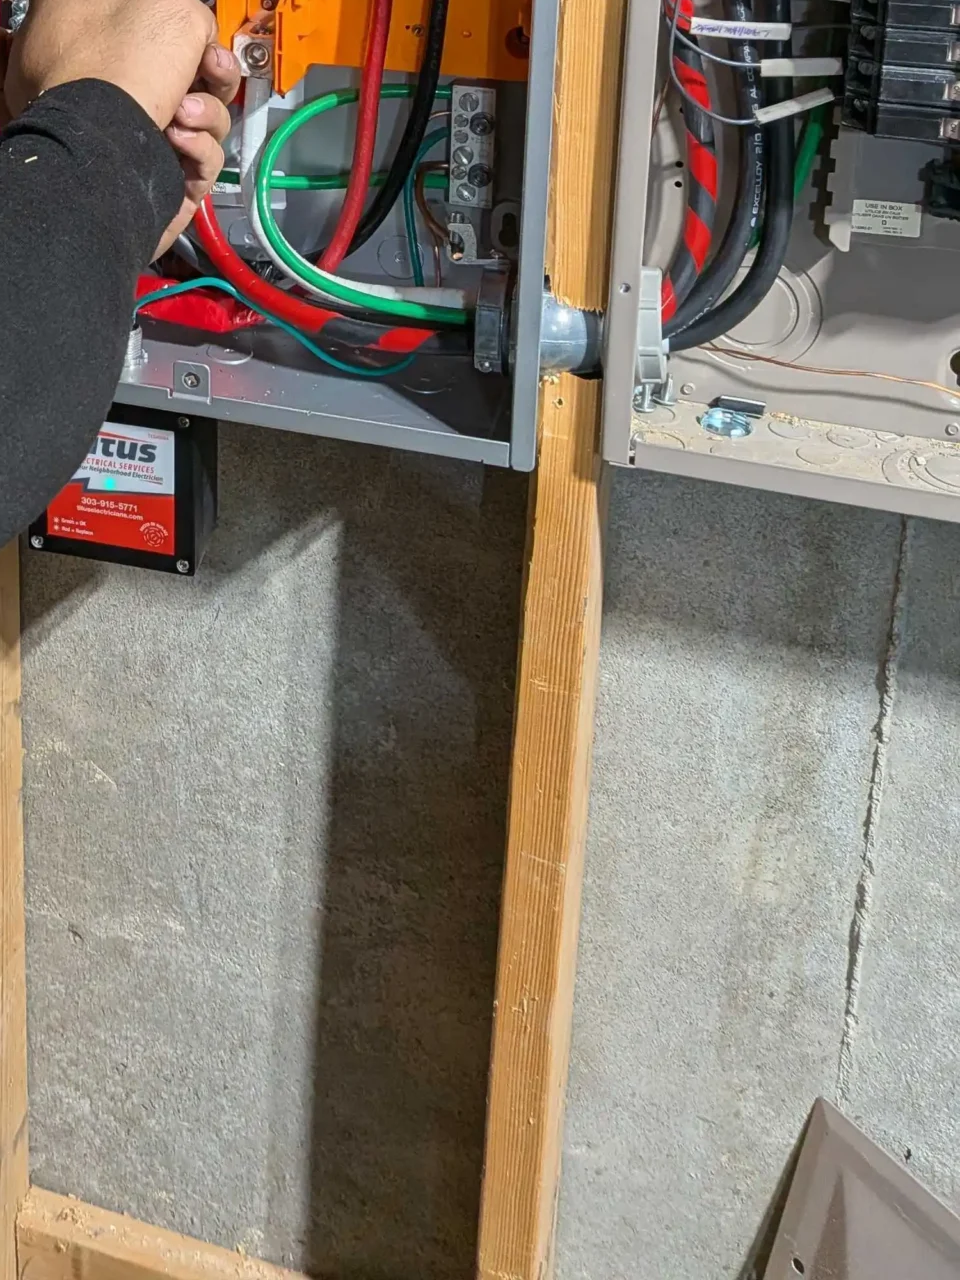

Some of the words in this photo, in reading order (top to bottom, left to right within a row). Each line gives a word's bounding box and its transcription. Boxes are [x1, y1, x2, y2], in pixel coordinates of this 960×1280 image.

[89, 437, 158, 463] itus
[85, 457, 117, 469] CTRICAL
[119, 462, 155, 474] SERVICES
[89, 466, 132, 477] Neighborhood
[132, 471, 164, 482] Electrician
[81, 496, 139, 513] 303-915-5771
